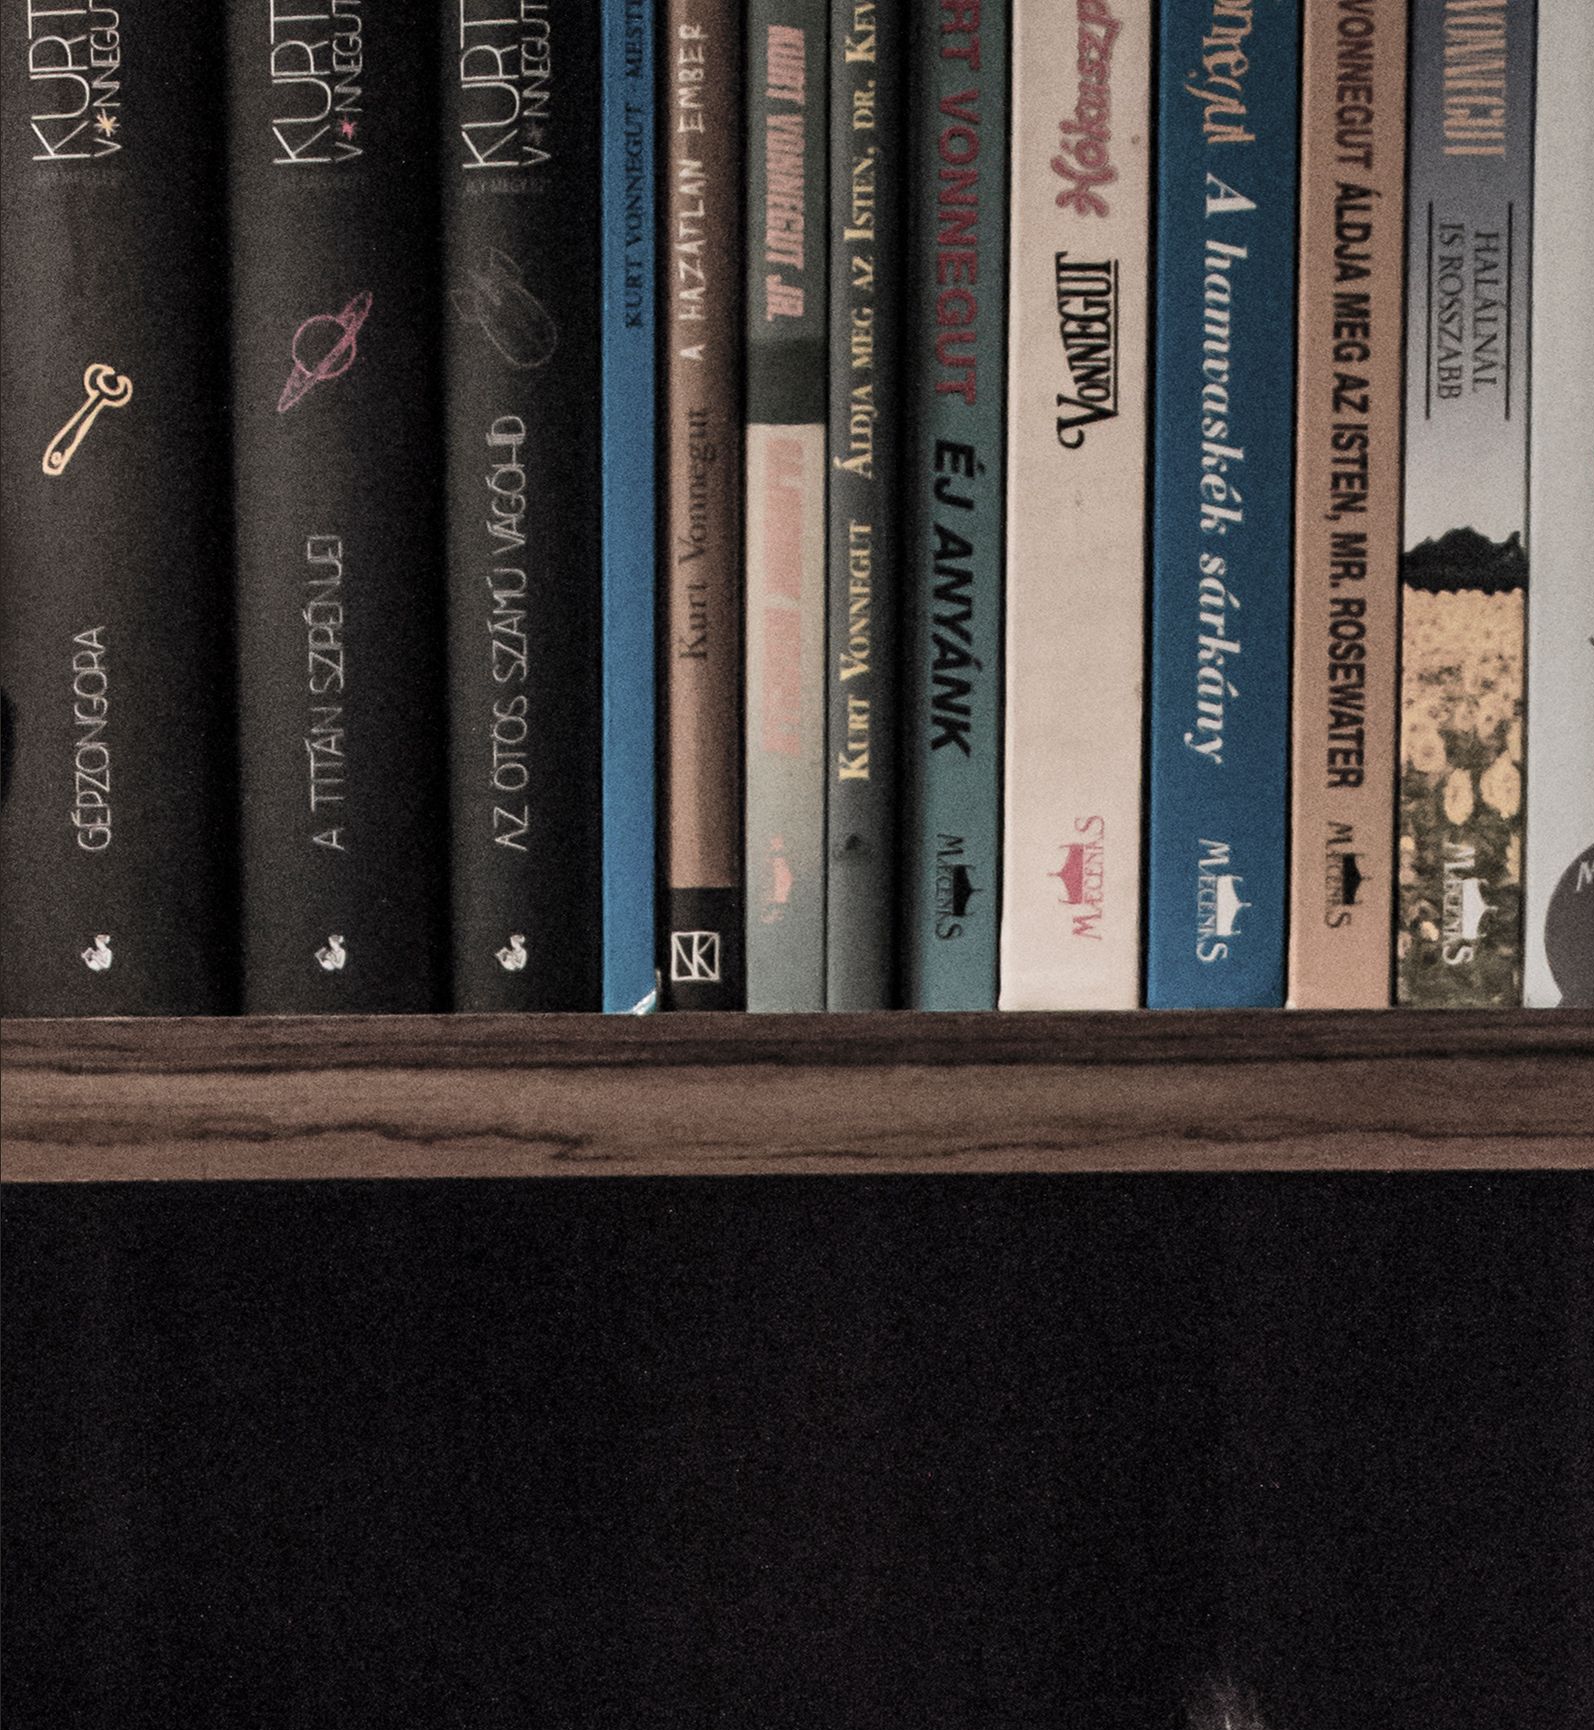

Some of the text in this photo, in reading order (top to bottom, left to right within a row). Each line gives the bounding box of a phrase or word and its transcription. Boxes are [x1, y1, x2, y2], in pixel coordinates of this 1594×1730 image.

[460, 0, 520, 169] KURT
[678, 24, 708, 135] EMBER
[766, 24, 805, 271] KURT VONNEGUT
[930, 89, 981, 756] VONNEGUT ÉJ ANYÁNK
[1055, 253, 1117, 450] VONNEGUT
[1471, 229, 1502, 394] HALÁLNÁL
[833, 307, 875, 782] KURT VONNEGUT ÁLDJA MEG
[1184, 172, 1258, 766] A hamvaskék sárkány
[1324, 182, 1375, 792] ÁLDJA MEG AZ ISTEN, ROSEWATER
[73, 625, 113, 852] GÉPZONGORA
[306, 703, 346, 851] A TITÁN
[490, 566, 529, 852] AZ ÖTÖS SZÁMÚ
